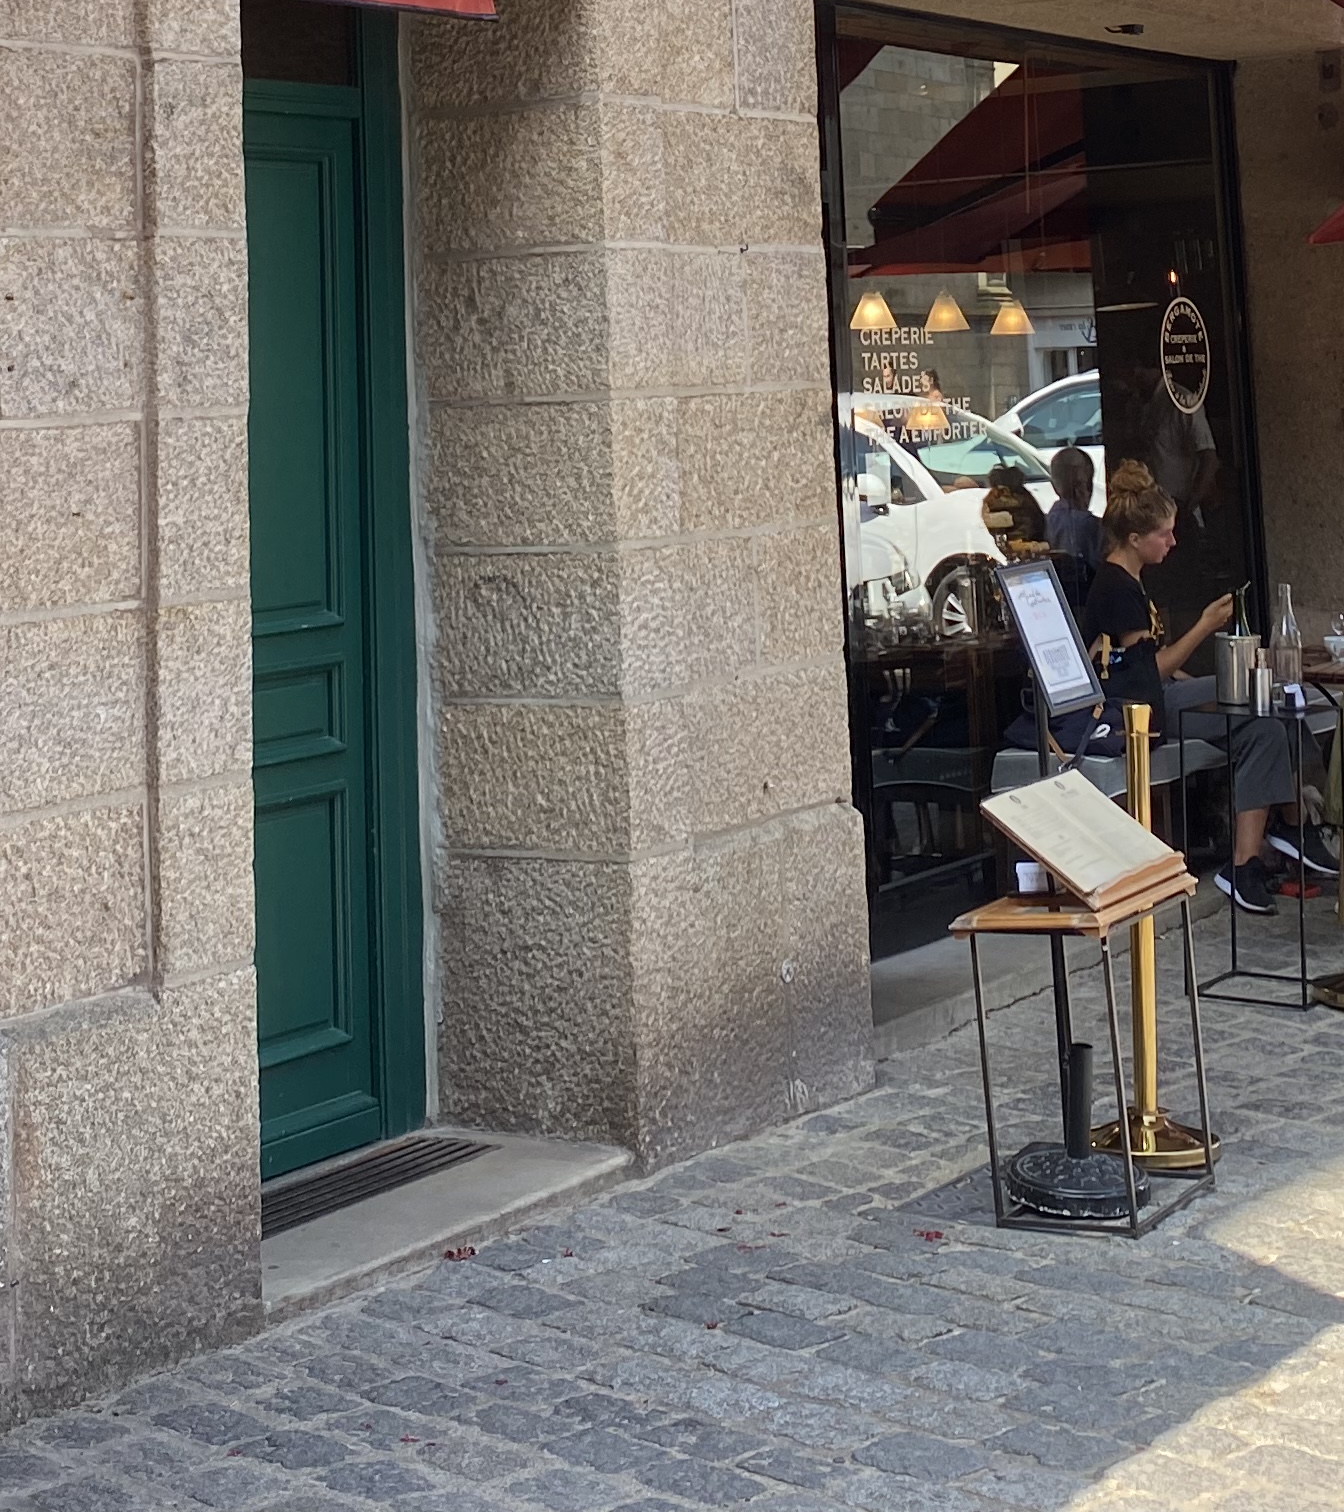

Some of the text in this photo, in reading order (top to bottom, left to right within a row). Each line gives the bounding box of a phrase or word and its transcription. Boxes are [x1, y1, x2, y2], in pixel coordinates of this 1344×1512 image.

[860, 327, 934, 346] CREPERIE
[861, 352, 919, 371] TARTES
[862, 374, 931, 394] SALADES
[942, 396, 971, 416] THE
